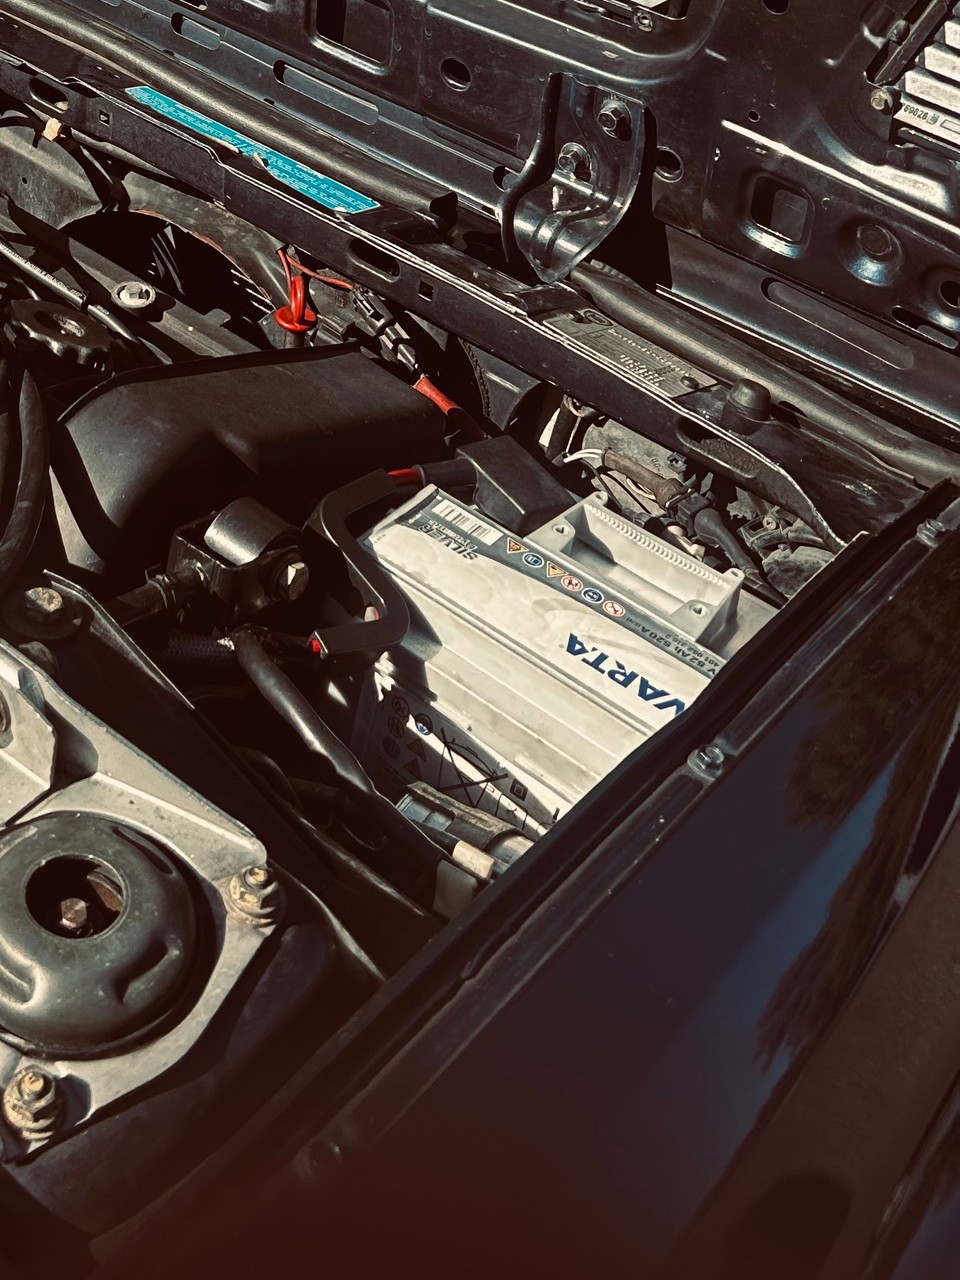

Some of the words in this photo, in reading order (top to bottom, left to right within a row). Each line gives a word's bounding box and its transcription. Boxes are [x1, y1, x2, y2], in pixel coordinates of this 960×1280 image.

[900, 102, 929, 120] 69626
[416, 524, 479, 560] SILVER
[565, 632, 686, 716] VARTA
